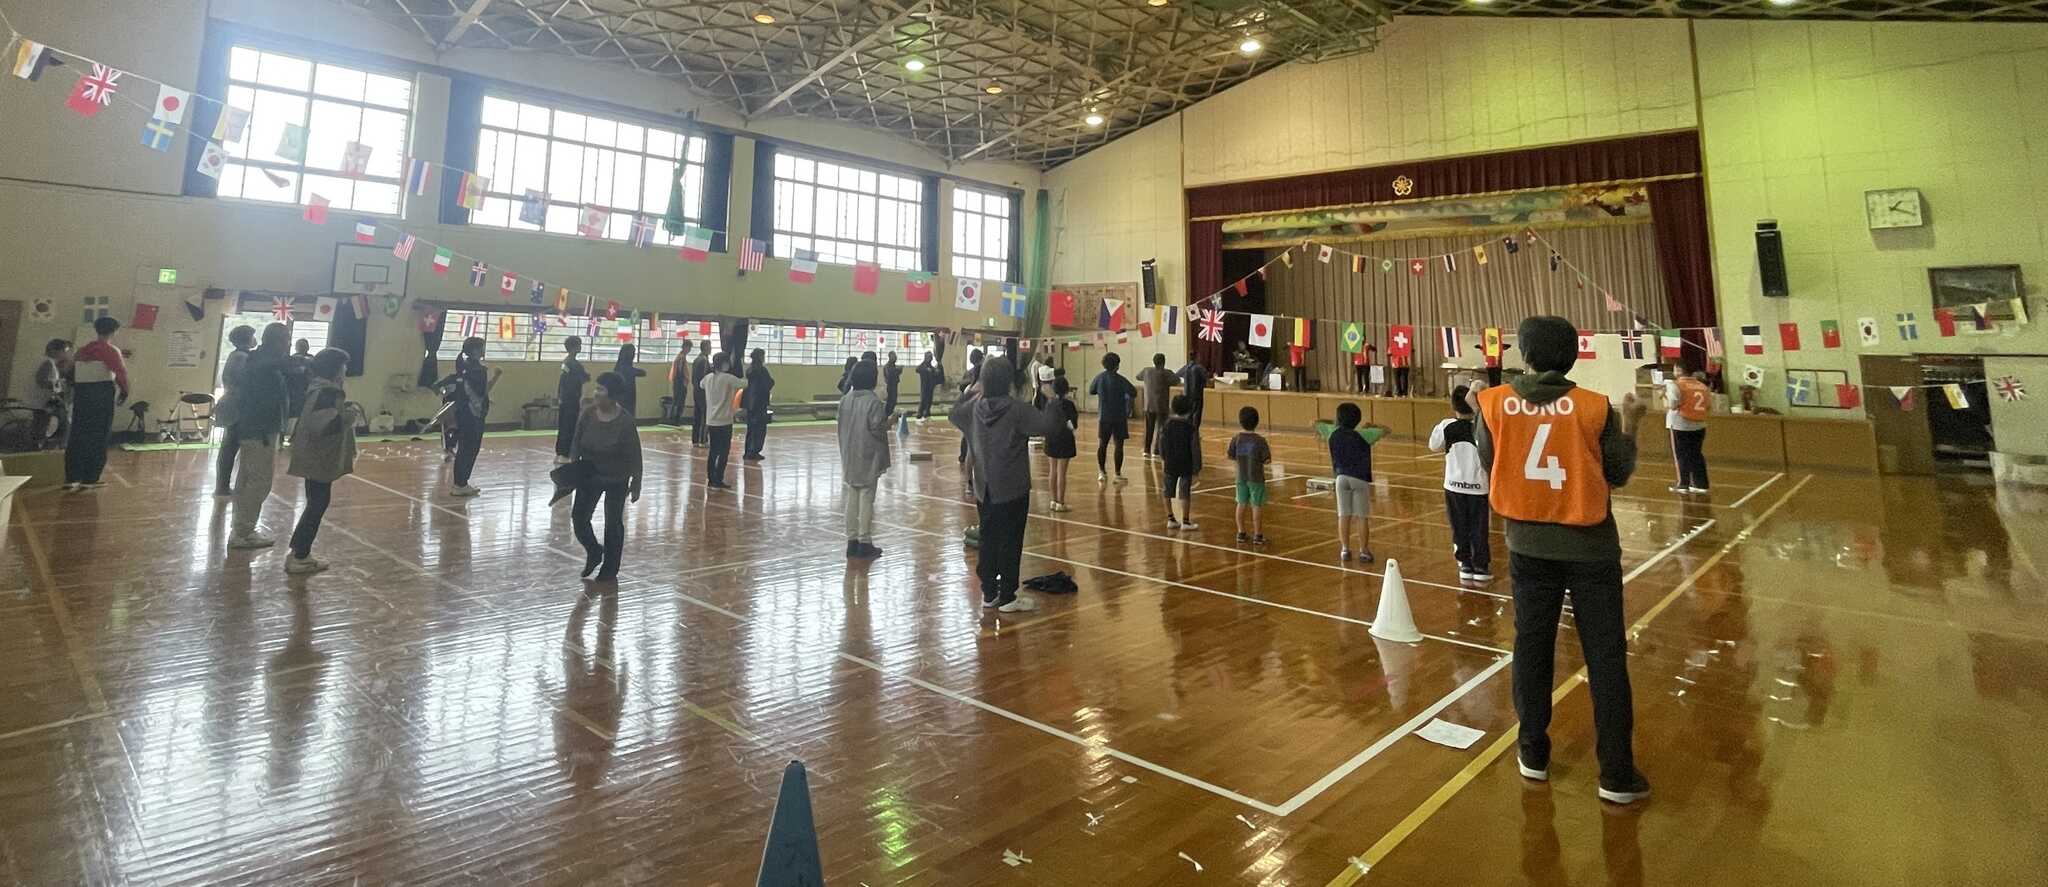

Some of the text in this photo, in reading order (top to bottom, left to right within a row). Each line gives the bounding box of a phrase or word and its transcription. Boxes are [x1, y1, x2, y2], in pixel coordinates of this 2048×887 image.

[1694, 391, 1705, 411] 2
[1524, 423, 1567, 490] 4
[1448, 480, 1481, 489] umbro
